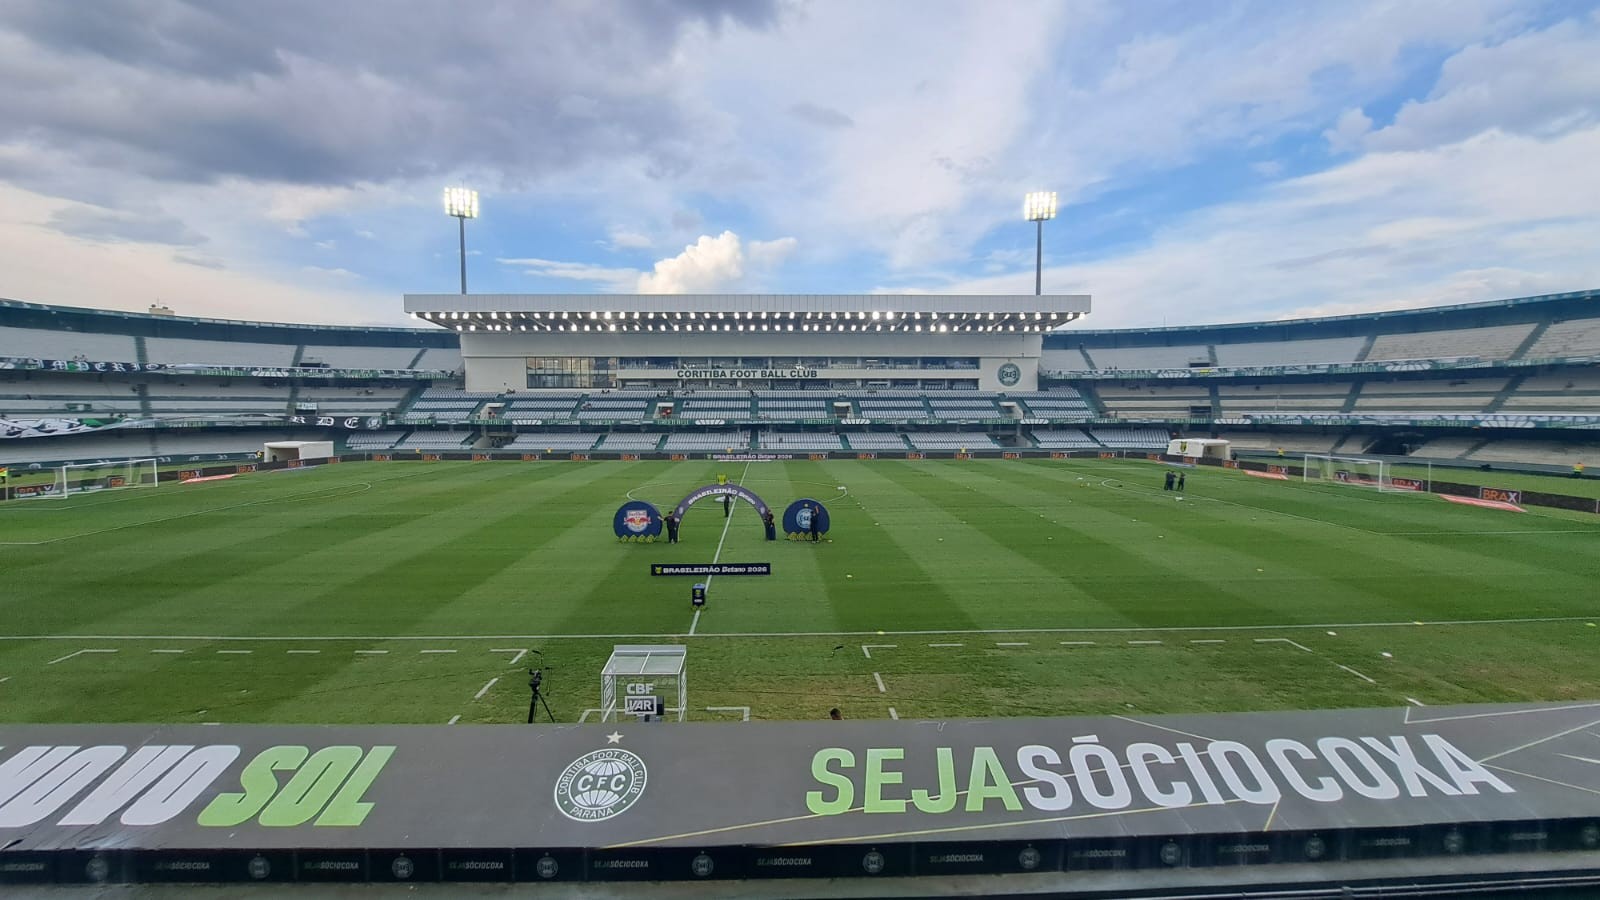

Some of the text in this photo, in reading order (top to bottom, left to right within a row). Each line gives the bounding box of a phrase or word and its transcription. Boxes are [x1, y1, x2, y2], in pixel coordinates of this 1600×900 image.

[677, 370, 818, 378] CORITIBA FOOT BALL CLUB
[688, 488, 737, 505] BRASILEIRÃO
[1482, 489, 1517, 503] BRAX
[663, 565, 720, 573] BRASILEIRÃO
[626, 683, 654, 694] CBF
[629, 700, 652, 711] VAR
[558, 751, 644, 795] CORITIBA FOOT BALL CLUB
[577, 774, 626, 791] CFC
